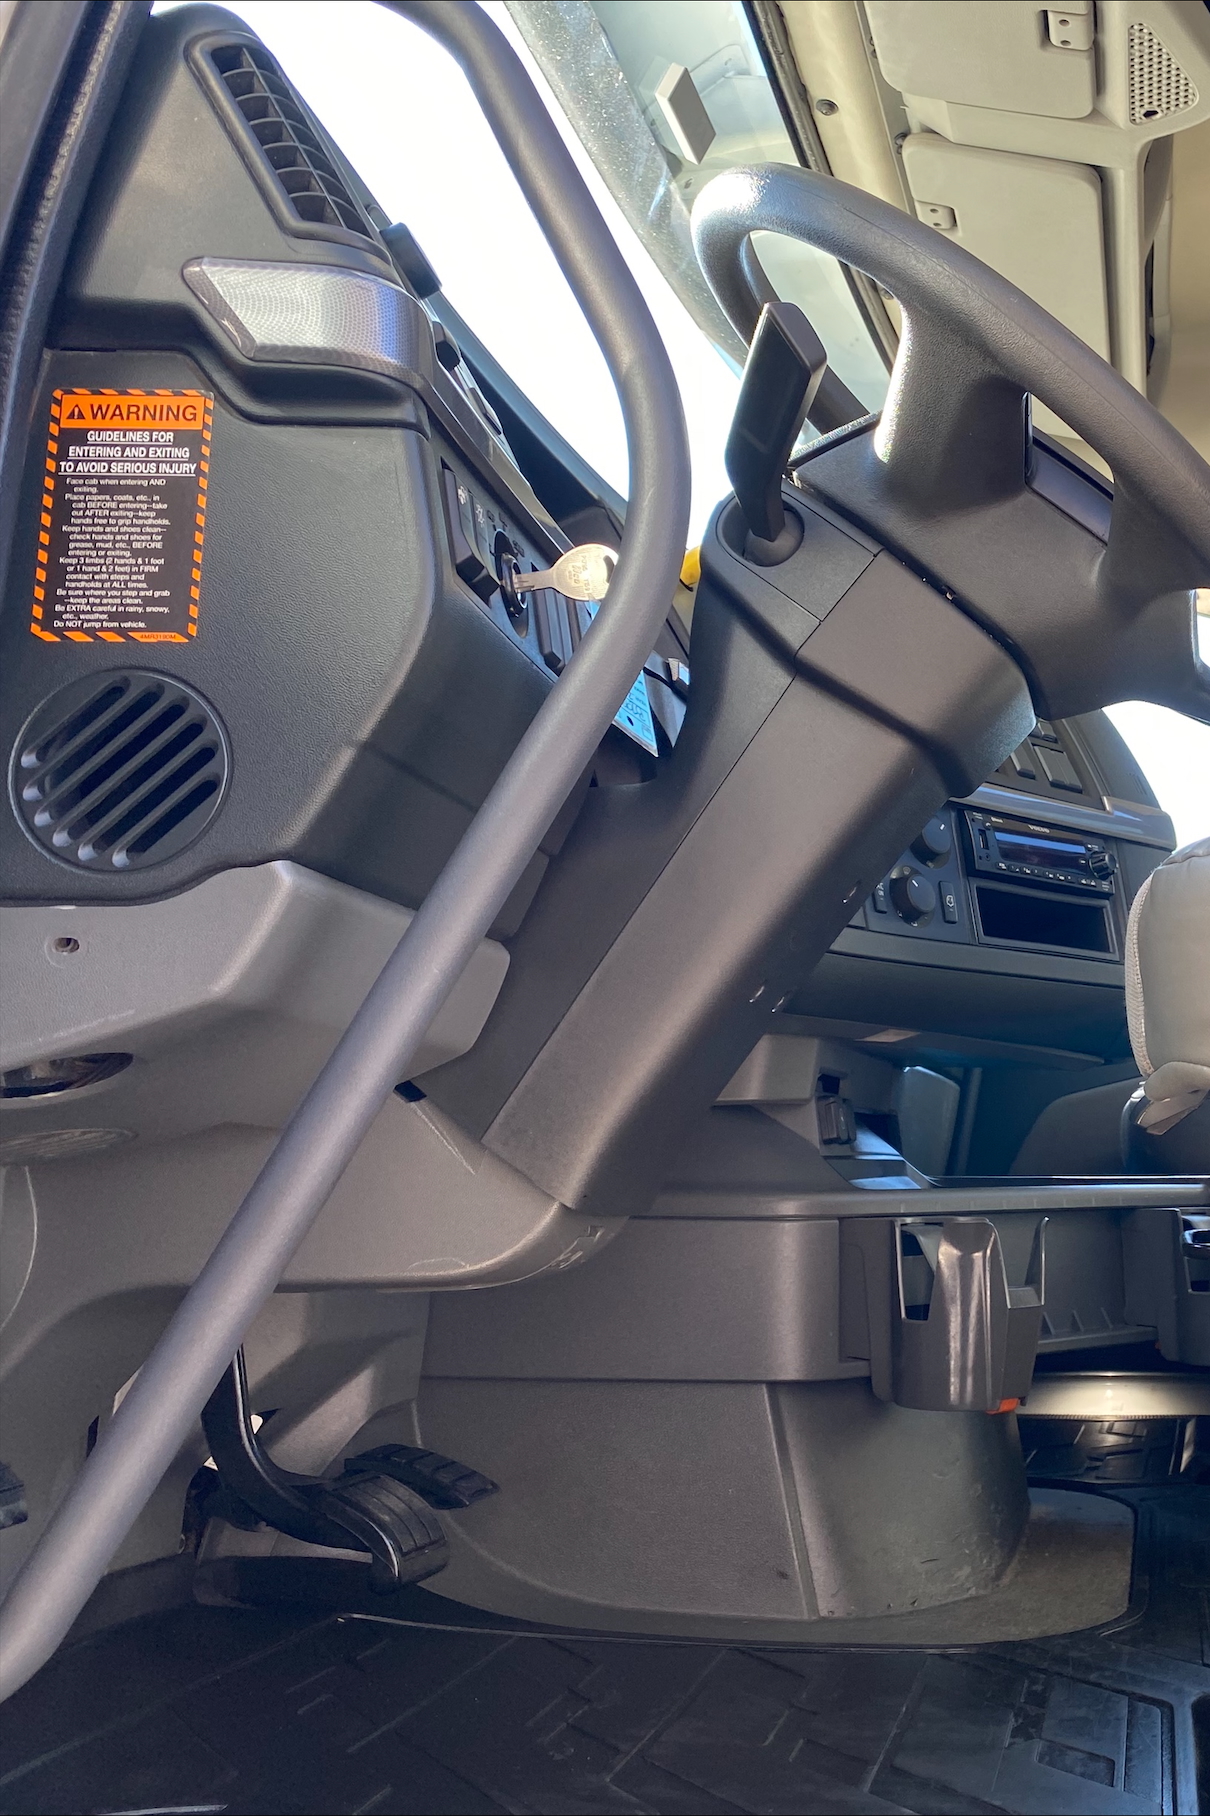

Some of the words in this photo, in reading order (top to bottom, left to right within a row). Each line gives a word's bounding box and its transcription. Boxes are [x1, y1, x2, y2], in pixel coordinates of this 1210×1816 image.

[90, 404, 196, 422] WARNING
[88, 431, 150, 442] GUIDELINES
[152, 431, 174, 442] FOR
[69, 447, 122, 458] ENTERING
[124, 447, 147, 458] AND
[149, 447, 190, 458] EXITING
[60, 462, 74, 473] TO
[76, 462, 108, 473] AVOID
[110, 462, 157, 473] SERIOUS
[159, 462, 197, 473] INJURY
[120, 478, 148, 487] entering
[149, 478, 166, 486] AND
